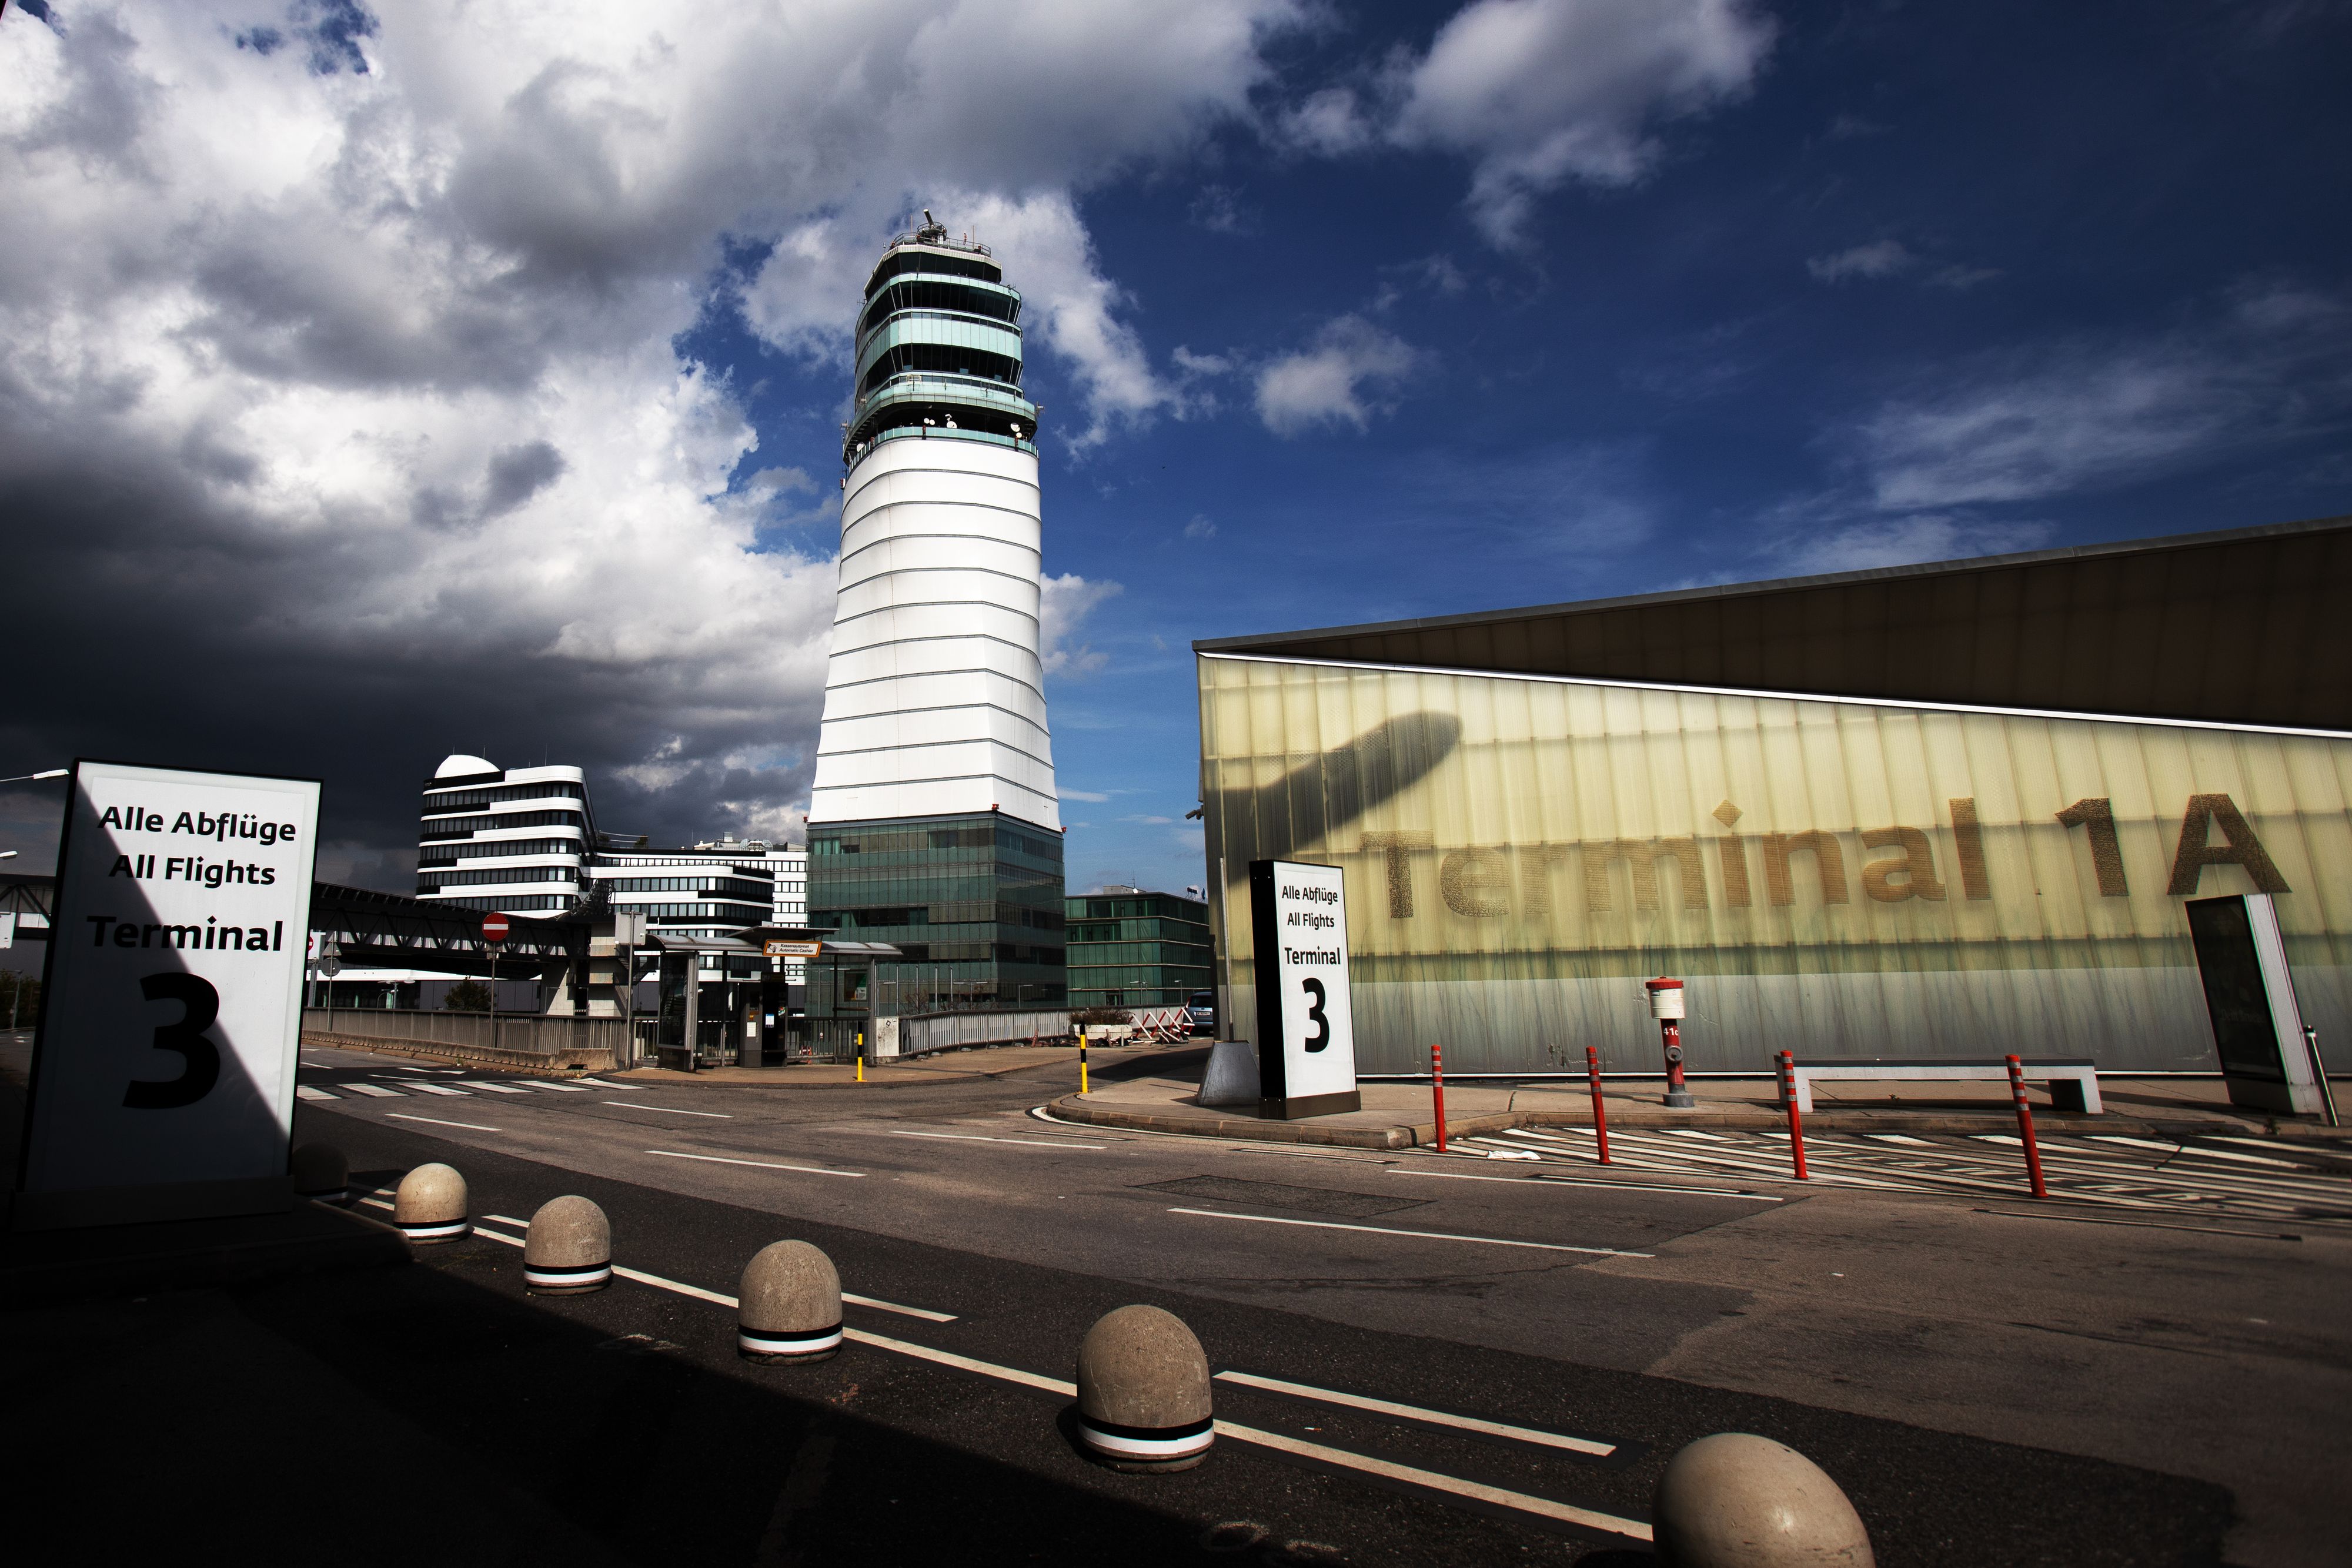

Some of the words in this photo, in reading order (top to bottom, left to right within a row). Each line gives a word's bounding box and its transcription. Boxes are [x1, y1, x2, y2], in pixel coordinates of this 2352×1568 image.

[98, 806, 164, 833] Alle
[171, 811, 296, 846] Abflüge
[108, 854, 155, 880] All
[165, 855, 276, 889] Flights
[1360, 797, 1993, 918] Terminal
[2054, 793, 2293, 898] 1A
[1282, 885, 1300, 900] Alle
[1302, 886, 1338, 905] Abflüge
[86, 915, 283, 952] Terminal
[1287, 912, 1300, 927] All
[1303, 912, 1335, 931] Flights
[1284, 945, 1341, 965] Terminal
[1302, 977, 1330, 1053] 3
[122, 971, 221, 1110] 3
